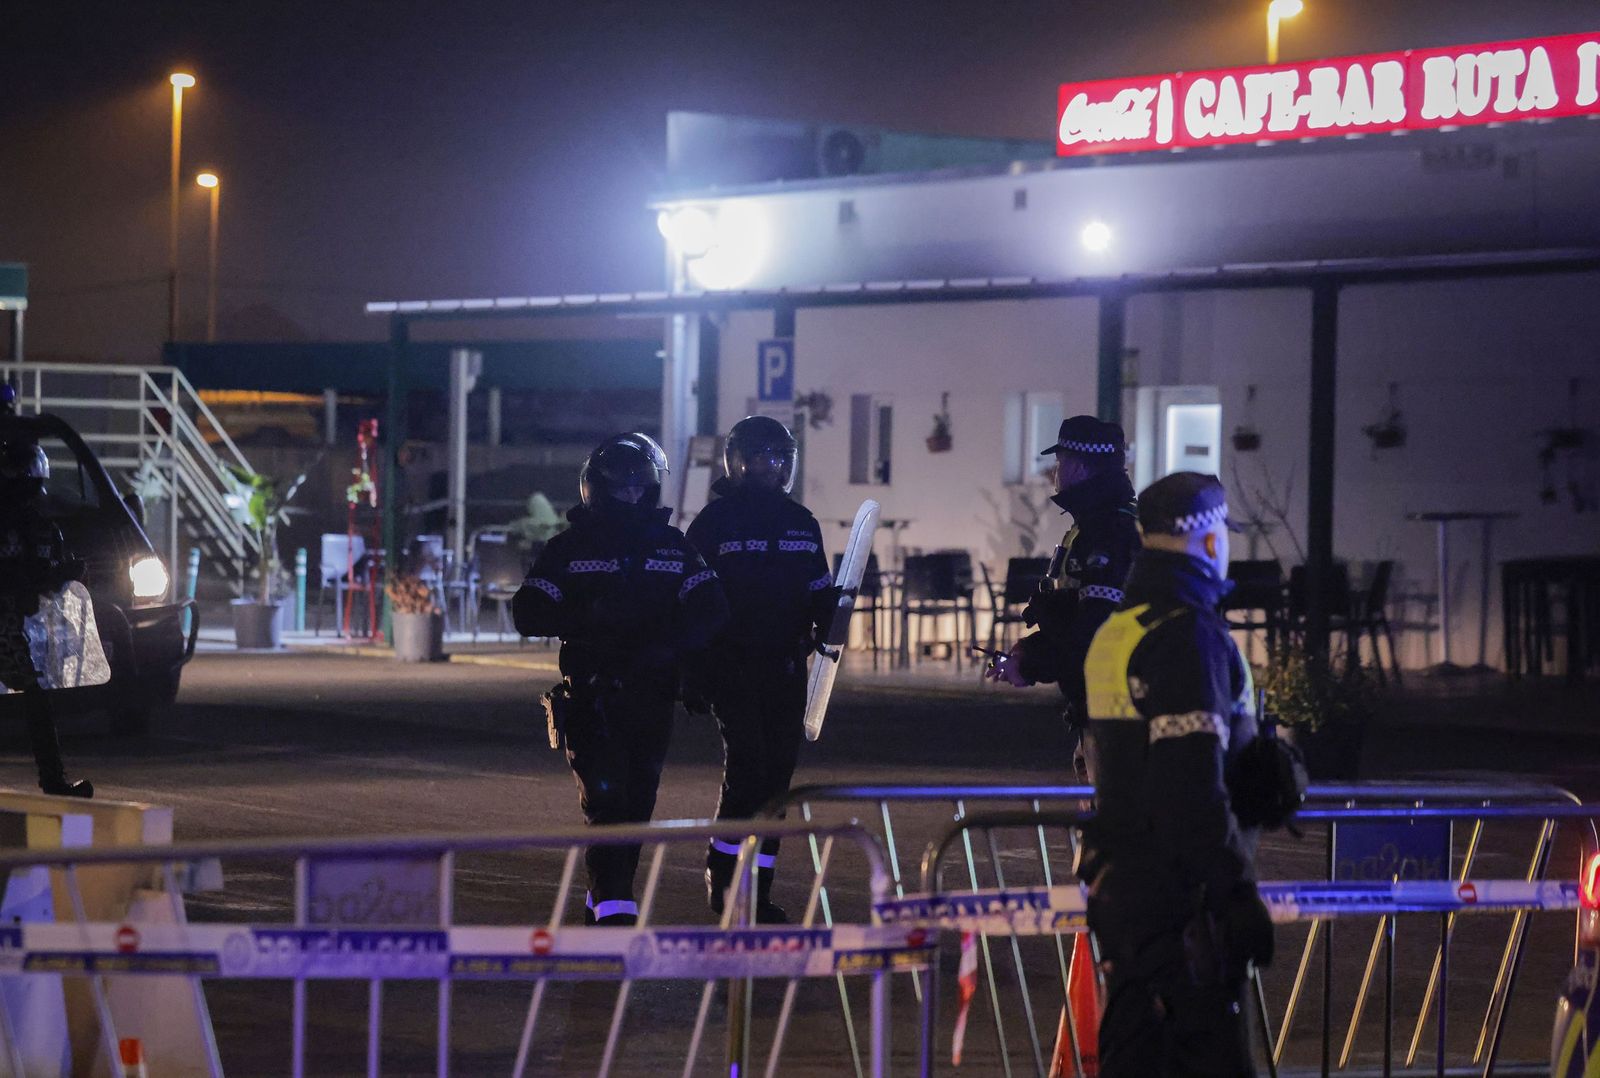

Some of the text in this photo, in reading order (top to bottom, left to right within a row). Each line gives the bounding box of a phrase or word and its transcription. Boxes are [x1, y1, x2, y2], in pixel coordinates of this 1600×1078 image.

[1184, 60, 1406, 139] CAFE-BAR
[1421, 46, 1559, 120] RUTA
[764, 346, 787, 395] P
